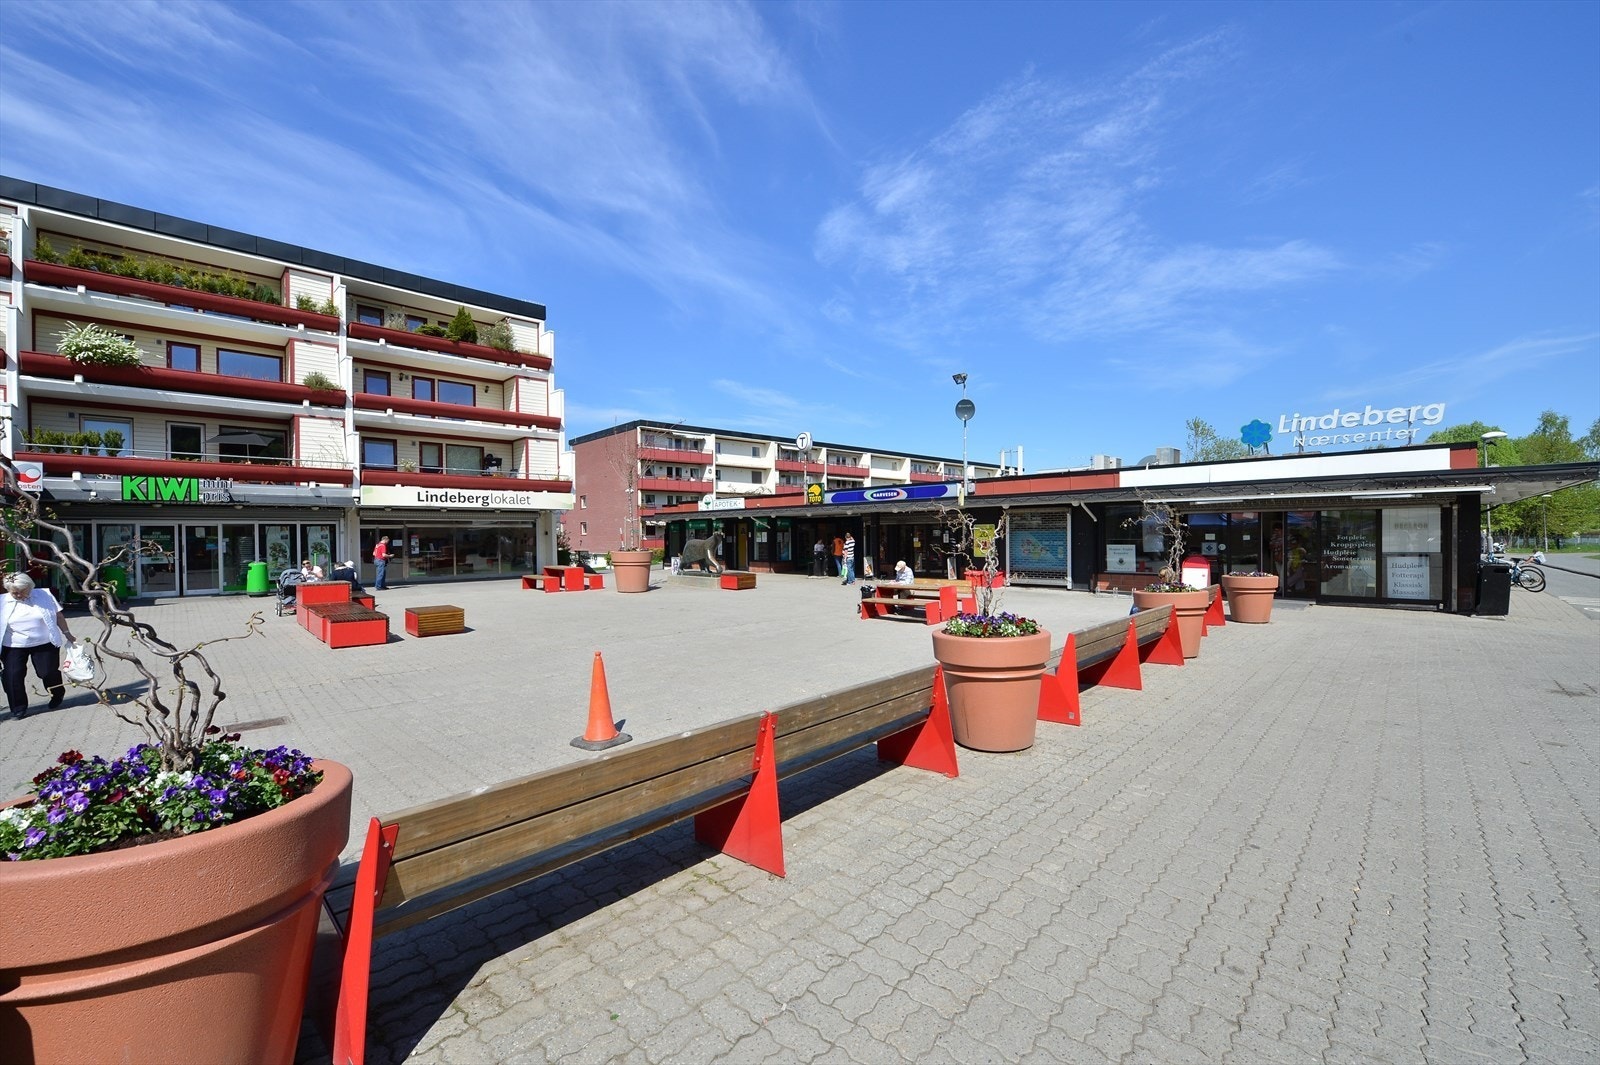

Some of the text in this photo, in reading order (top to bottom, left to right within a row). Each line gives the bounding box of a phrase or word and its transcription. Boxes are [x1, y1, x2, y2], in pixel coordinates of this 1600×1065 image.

[1278, 402, 1446, 434] Lindeberg
[1293, 427, 1420, 447] Nærsenter
[121, 475, 200, 502] KIWI
[203, 477, 234, 489] mini
[203, 490, 231, 503] pris
[417, 490, 531, 507] Lindeberglokalet
[714, 500, 738, 508] APOTEK
[1330, 541, 1376, 549] Kroppspleie
[1391, 562, 1424, 570] Hudpleie
